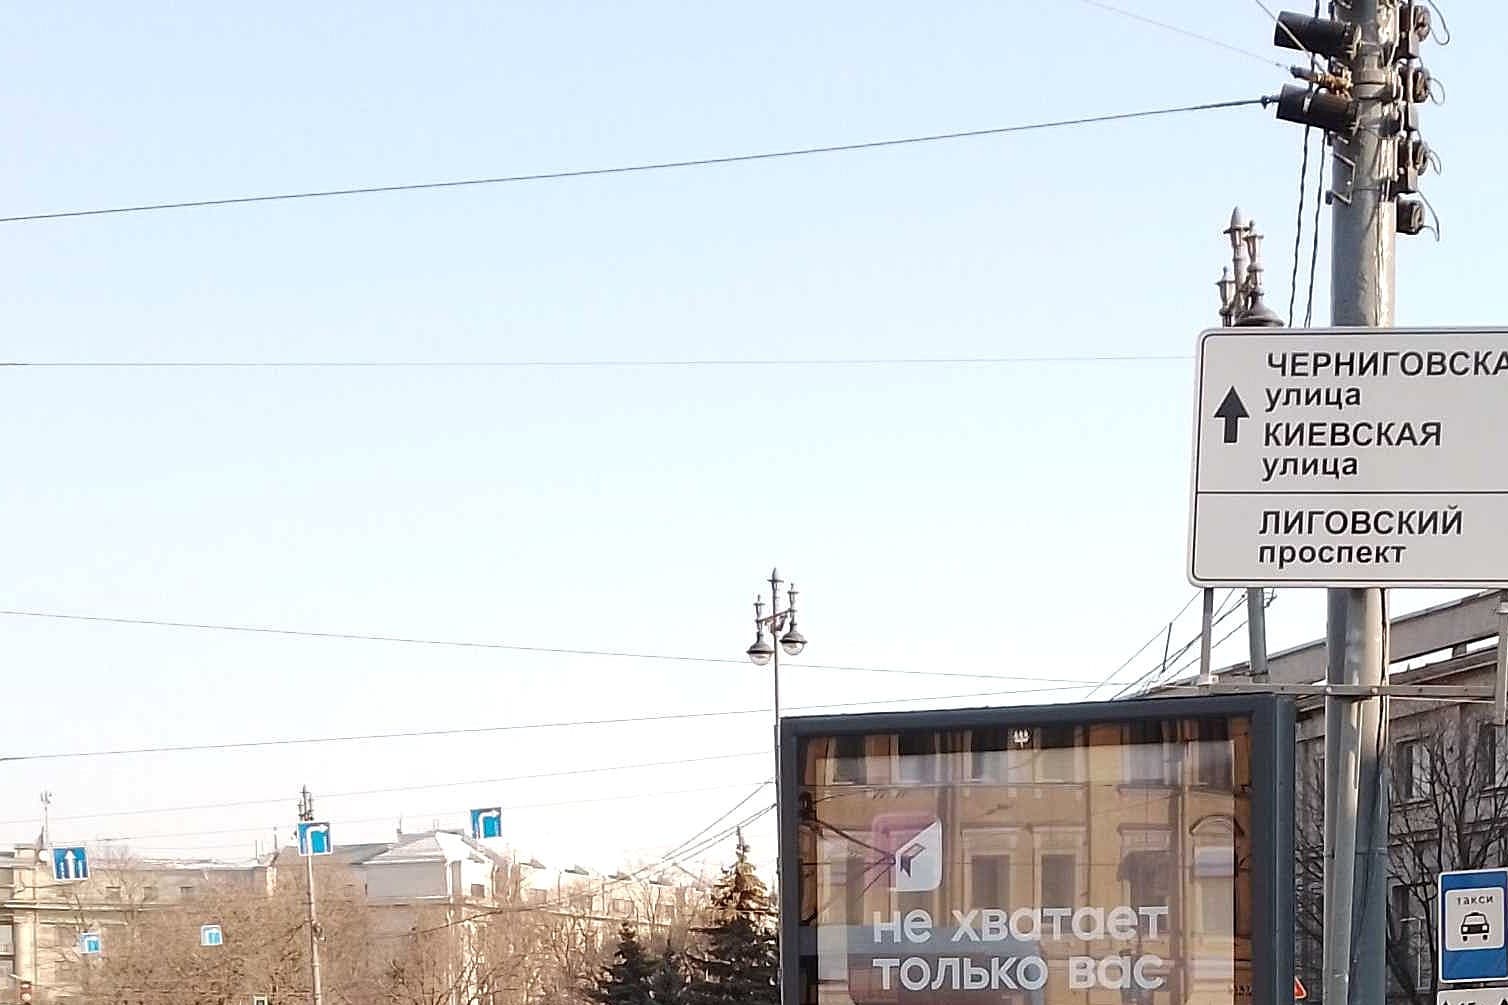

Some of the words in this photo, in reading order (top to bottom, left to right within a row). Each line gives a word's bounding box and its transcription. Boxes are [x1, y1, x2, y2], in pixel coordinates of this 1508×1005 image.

[1264, 382, 1361, 412] улица
[1263, 421, 1442, 447] КИЕВСКАЯ
[1261, 453, 1359, 482] улица
[1258, 504, 1463, 536] ЛИГОВСКИЙ
[1257, 542, 1406, 567] проспект
[1456, 895, 1494, 906] такси
[872, 907, 933, 944] не
[950, 904, 1170, 944] хватает
[873, 955, 1049, 992] только
[1069, 953, 1167, 991] вас
